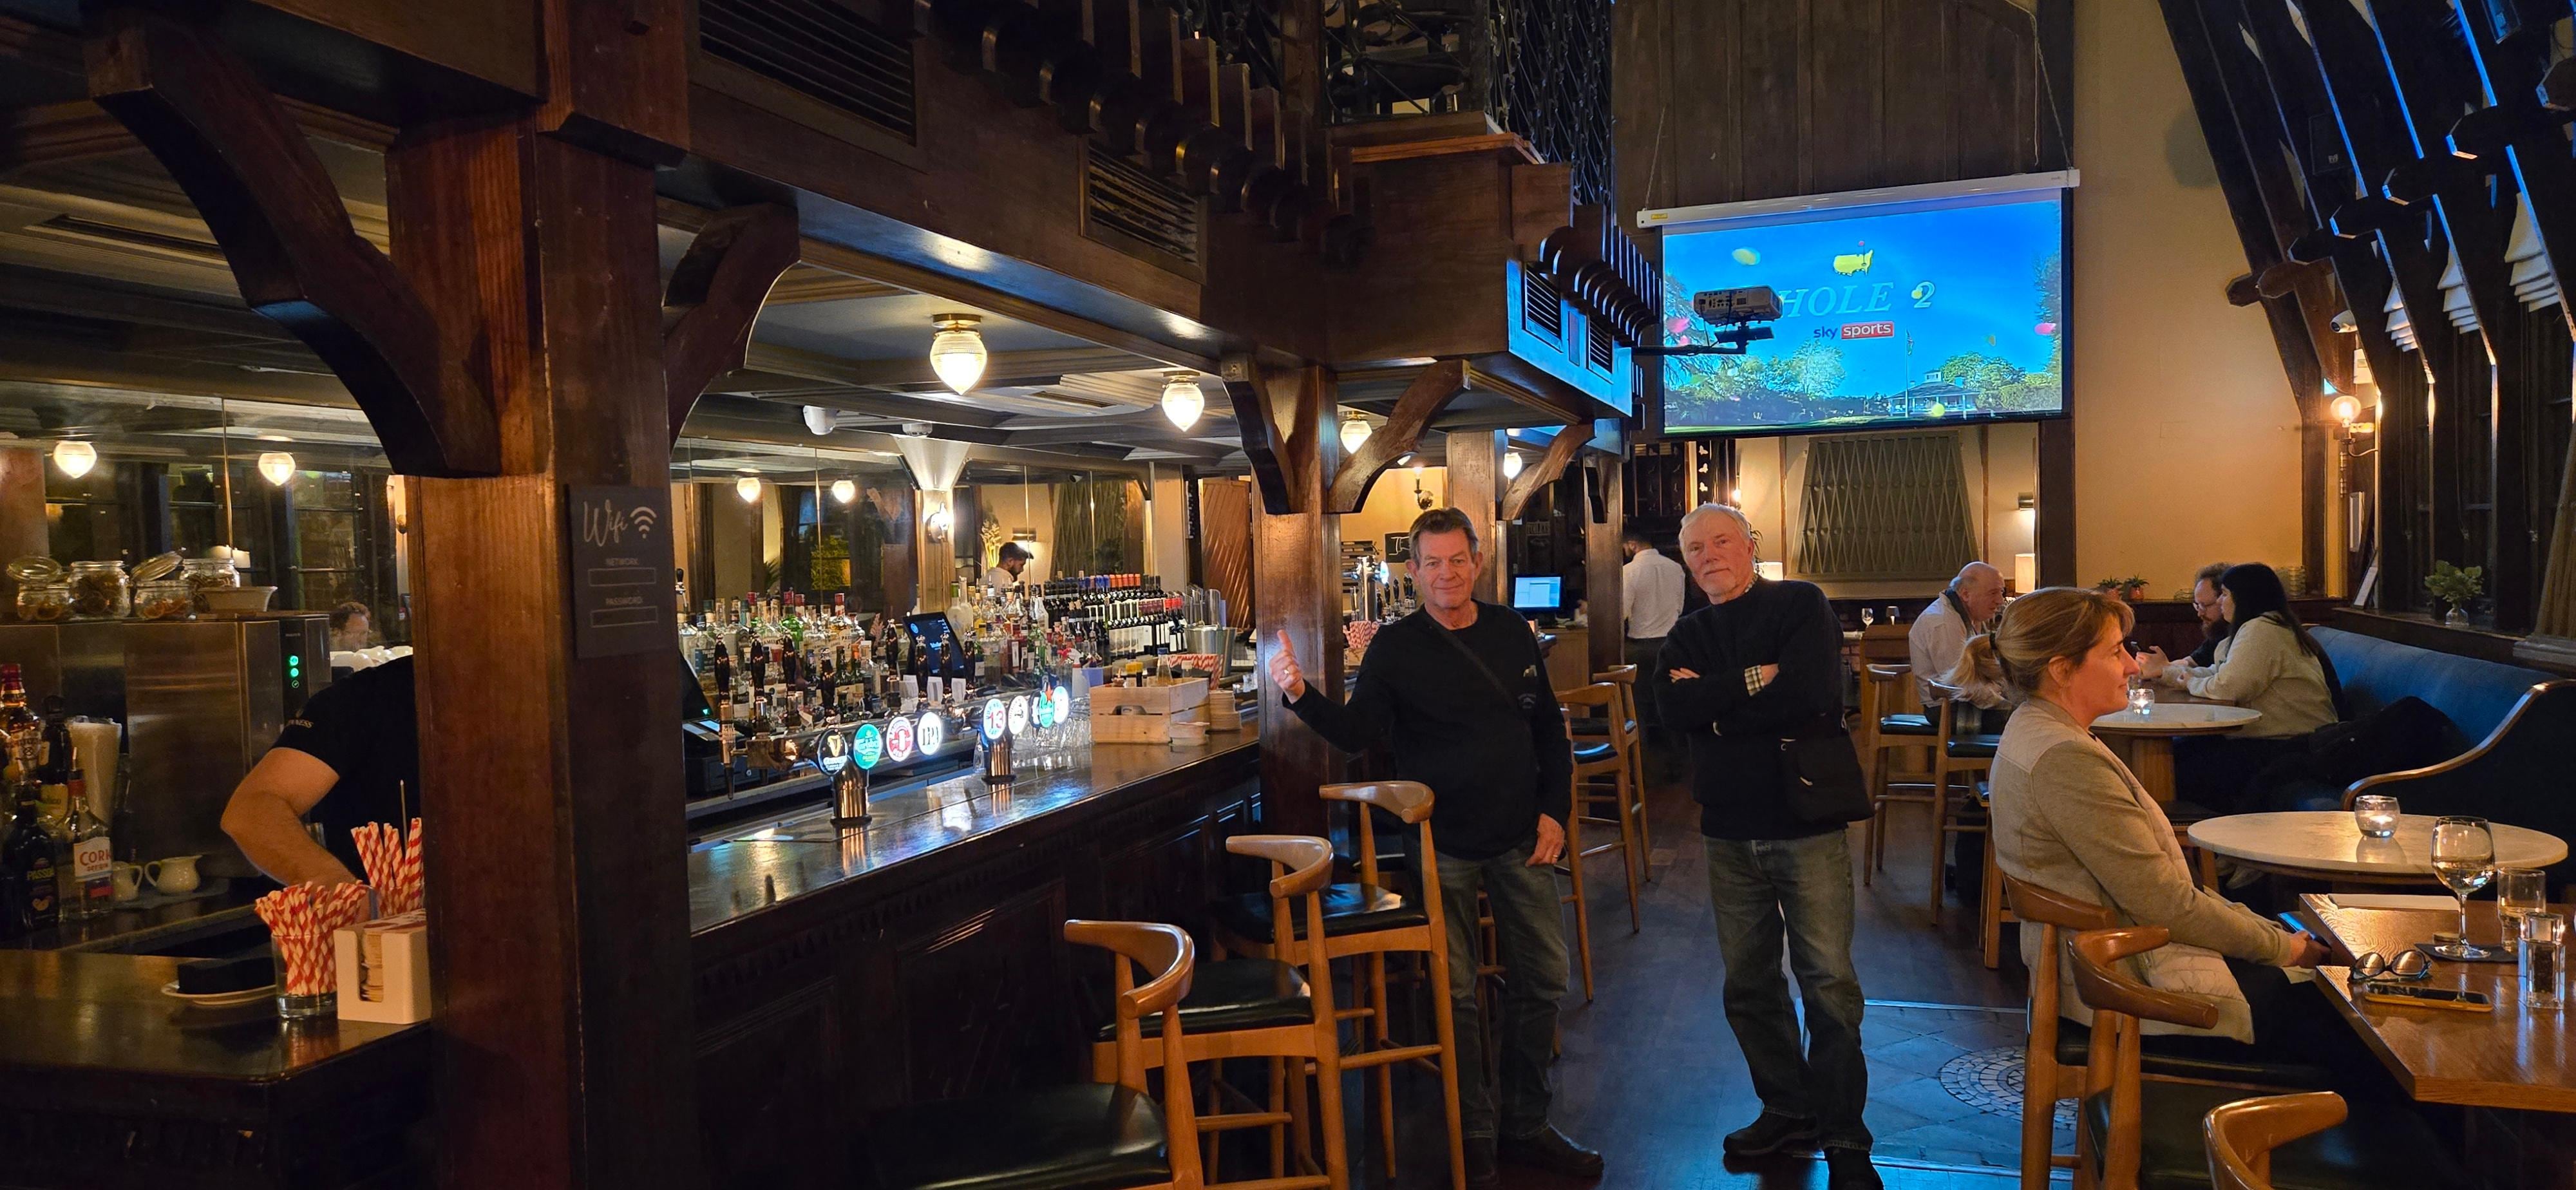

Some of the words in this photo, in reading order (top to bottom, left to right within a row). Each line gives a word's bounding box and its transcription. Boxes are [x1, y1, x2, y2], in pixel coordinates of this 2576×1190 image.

[1778, 282, 1894, 318] HOLE
[1911, 281, 1935, 308] 2
[1813, 326, 1839, 340] sky
[1842, 323, 1891, 338] sports
[583, 499, 628, 547] Wifi
